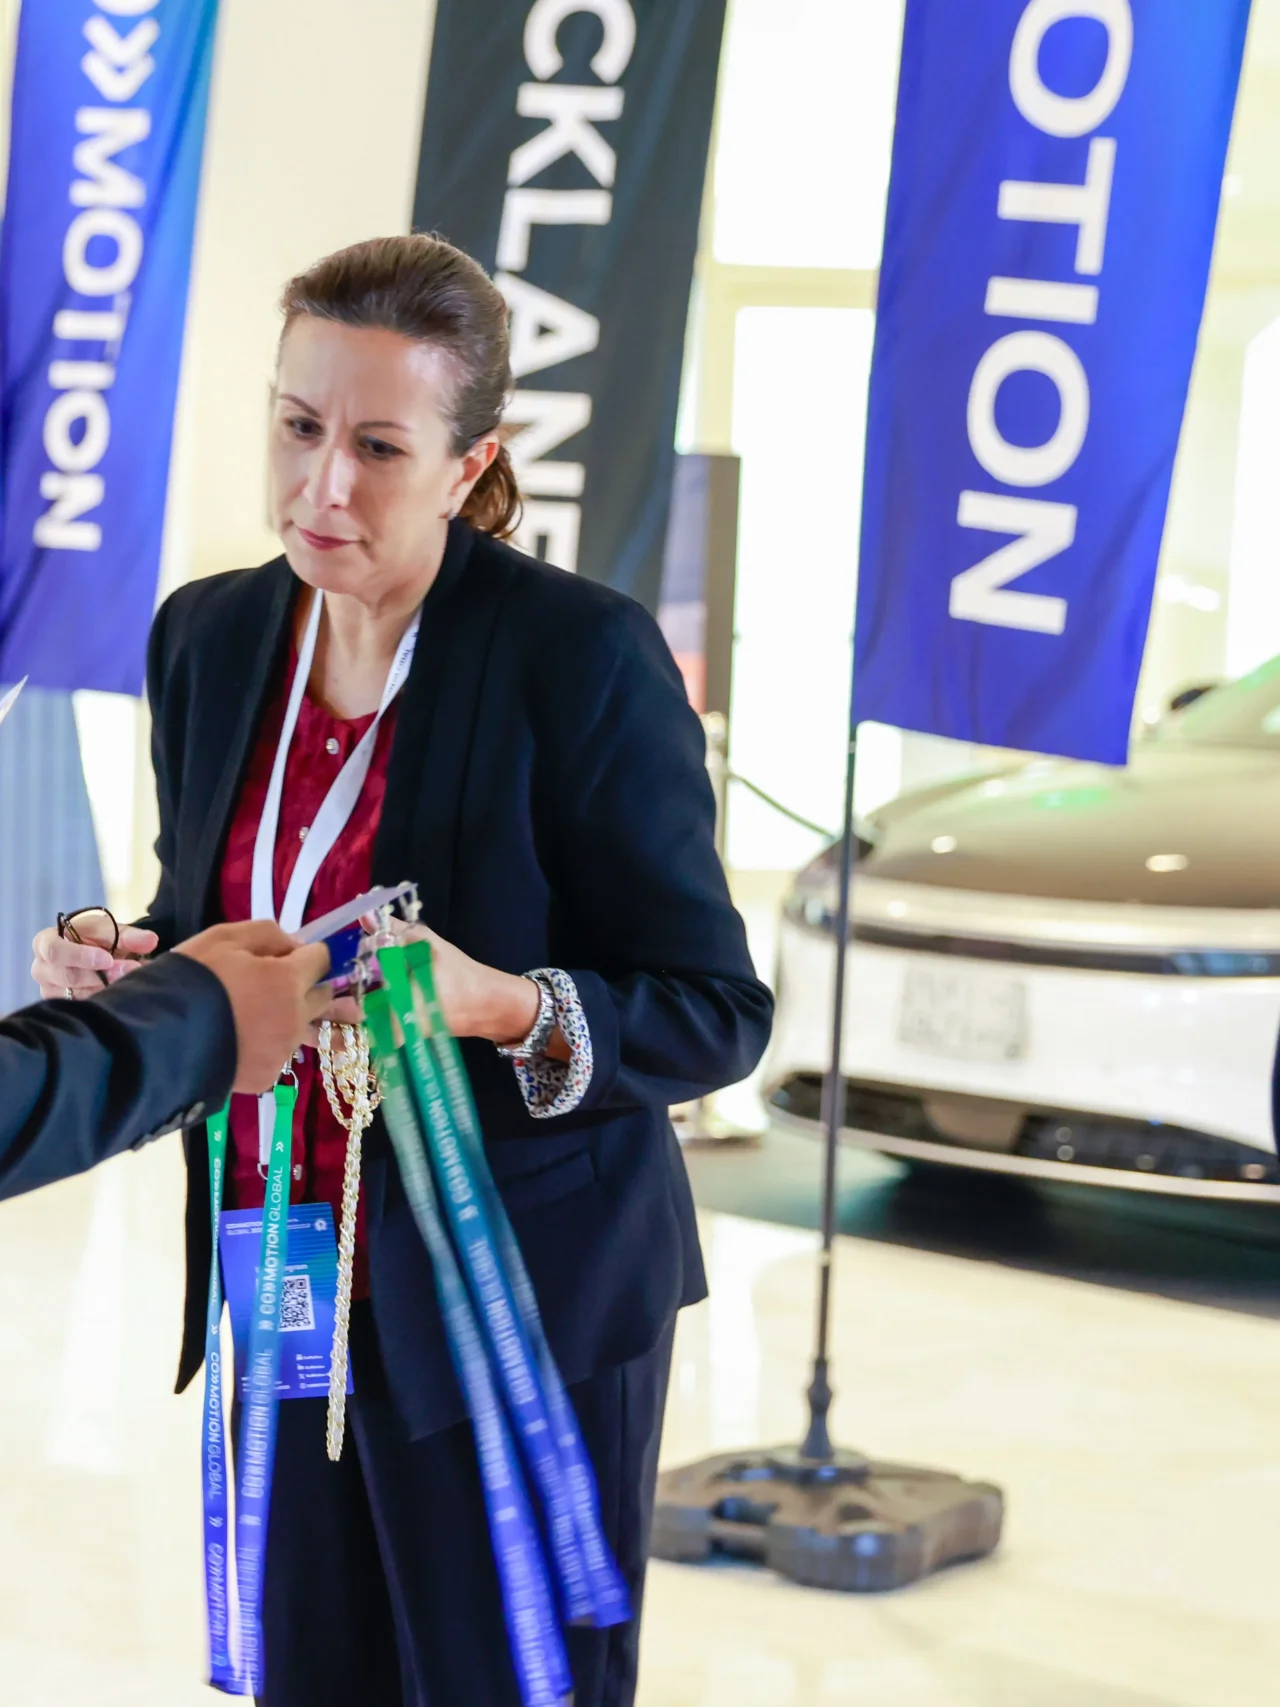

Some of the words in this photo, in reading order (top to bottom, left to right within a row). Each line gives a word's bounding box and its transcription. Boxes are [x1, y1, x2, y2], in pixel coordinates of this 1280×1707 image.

[948, 0, 1134, 636] OTION
[268, 1166, 284, 1222] GLOBAL
[207, 1443, 224, 1501] GLOBAL
